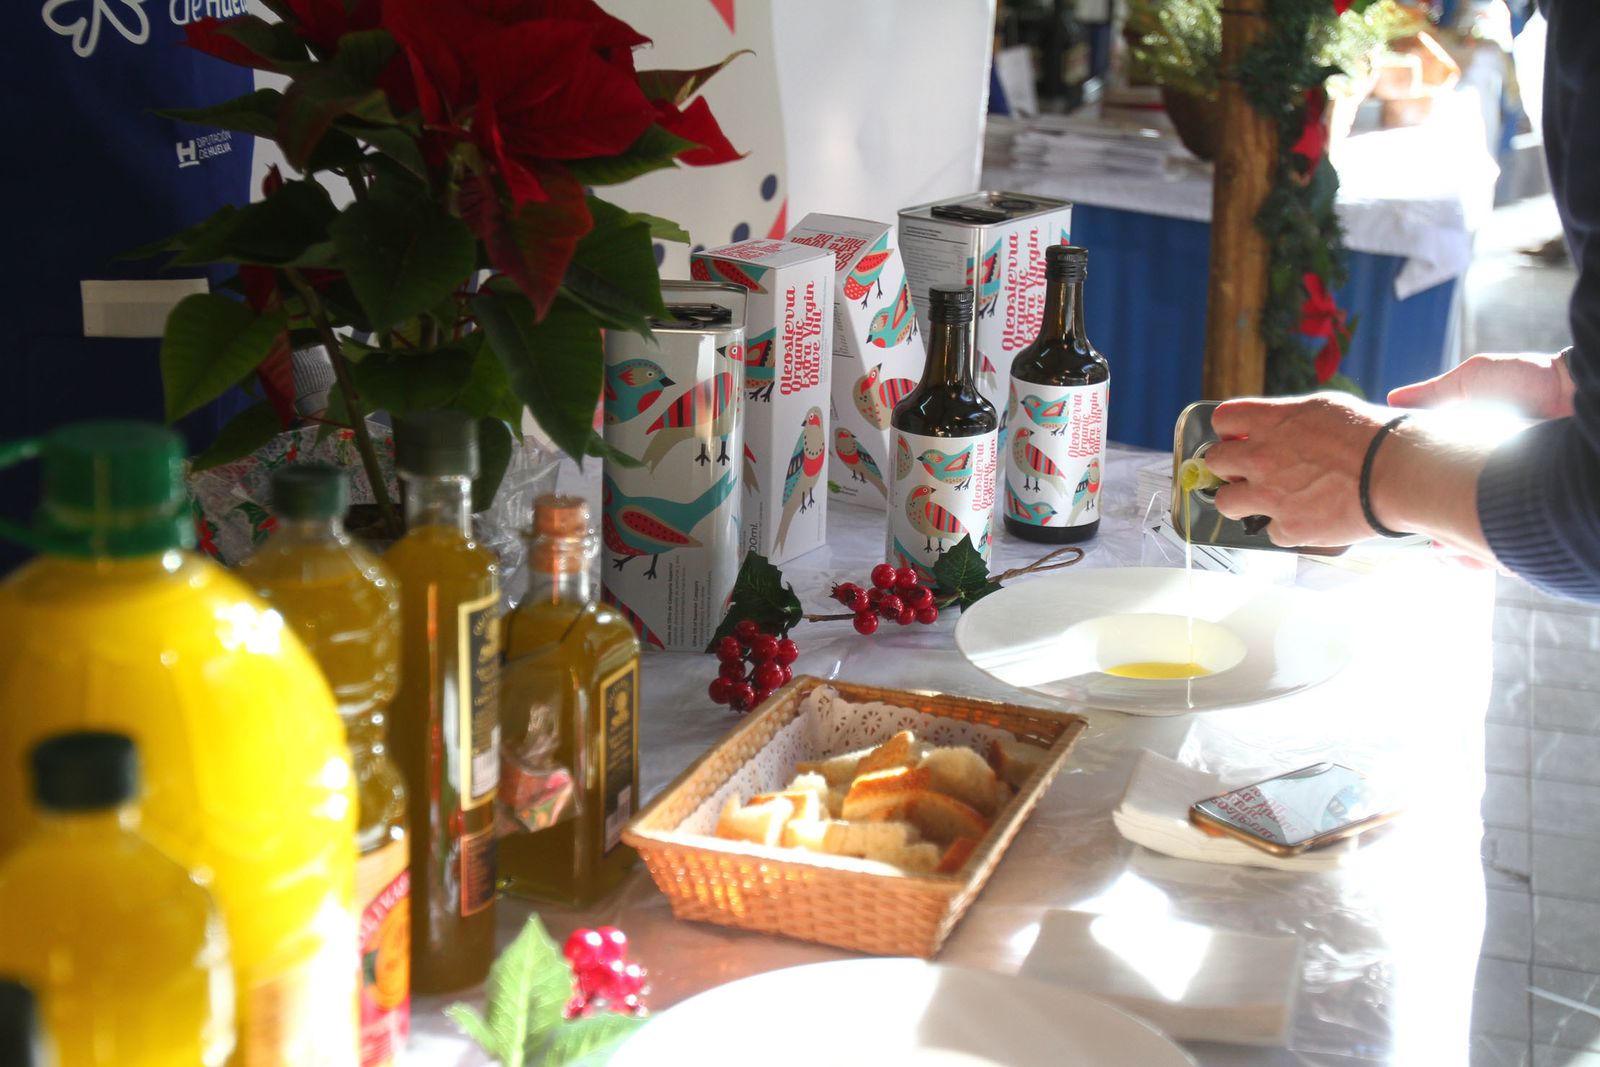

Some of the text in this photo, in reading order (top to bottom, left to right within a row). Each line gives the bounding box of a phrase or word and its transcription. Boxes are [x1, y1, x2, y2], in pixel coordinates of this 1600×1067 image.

[1002, 231, 1018, 351] Oleosierra
[1012, 268, 1028, 348] Organic
[1021, 227, 1041, 344] Extra Virgin
[780, 286, 796, 396] Oleosierra
[790, 319, 806, 392] Organic
[799, 280, 817, 389] Extra Virgin
[810, 309, 823, 386] Olive Oil
[1068, 394, 1083, 458] Oleosierra
[1078, 415, 1091, 457] Organic
[971, 443, 985, 512] Oleosierra
